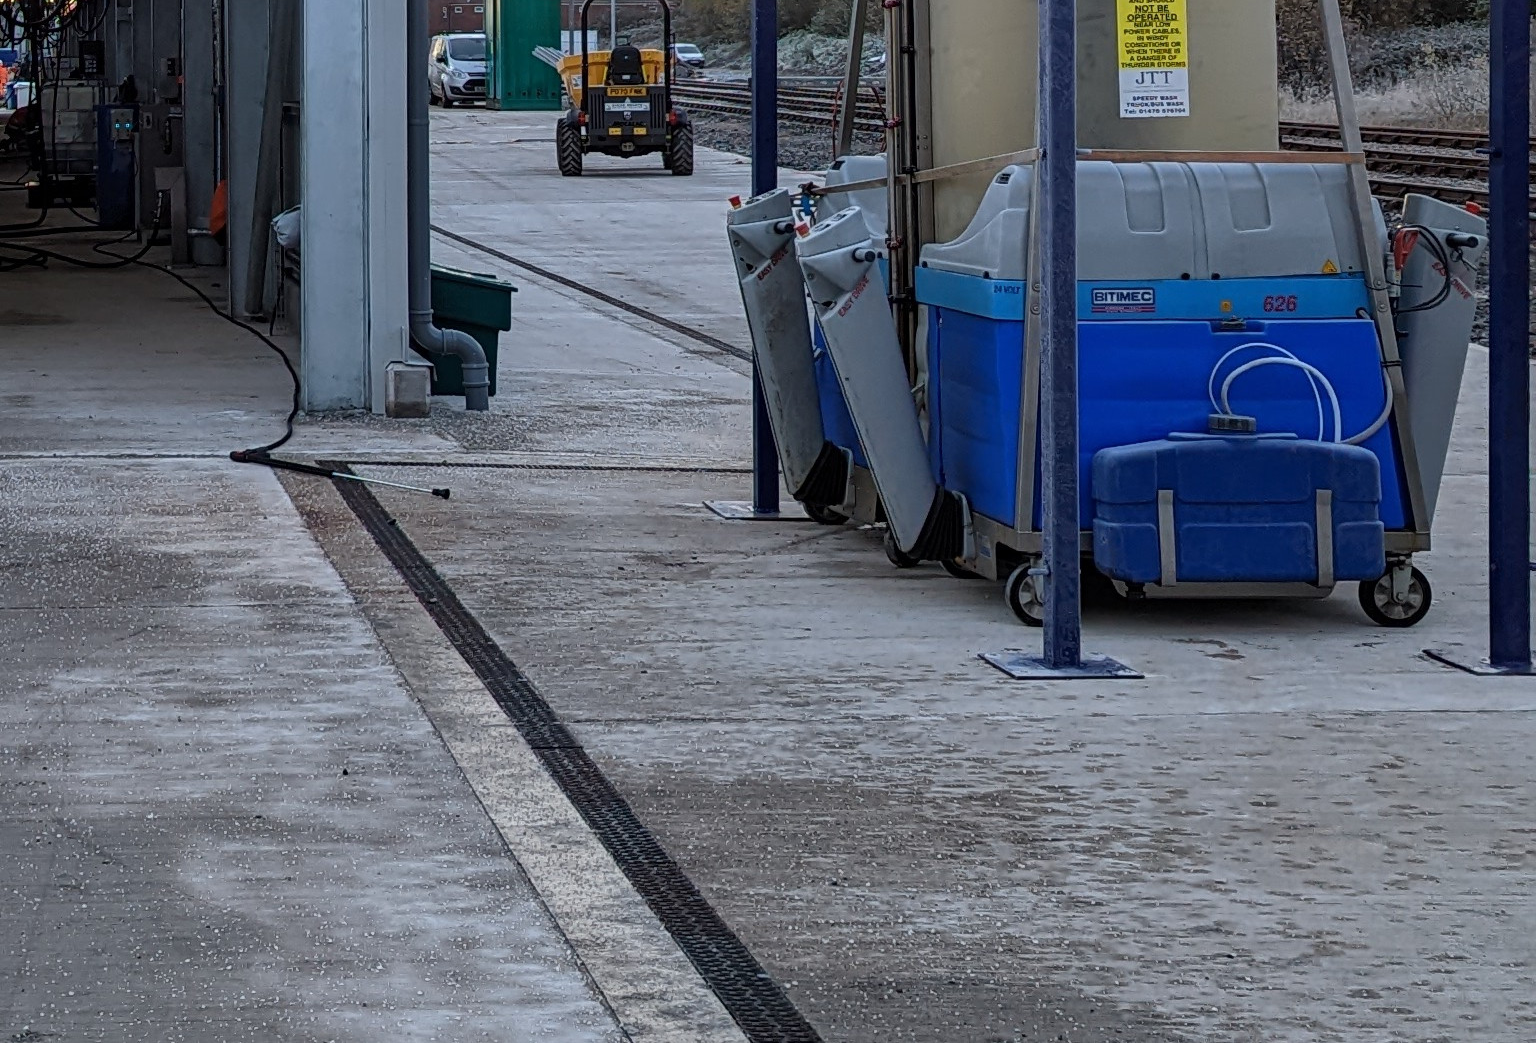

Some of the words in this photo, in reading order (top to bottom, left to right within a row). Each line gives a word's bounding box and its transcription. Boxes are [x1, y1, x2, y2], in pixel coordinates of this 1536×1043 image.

[1134, 4, 1155, 13] NOT
[1157, 4, 1170, 13] BE
[1126, 13, 1178, 22] OPERATED
[1135, 70, 1174, 85] JTT
[756, 265, 774, 281] EASY
[1003, 285, 1021, 295] VOLT
[1094, 291, 1153, 303] BITIMEC
[1263, 294, 1298, 313] 626
[838, 297, 856, 317] EASY
